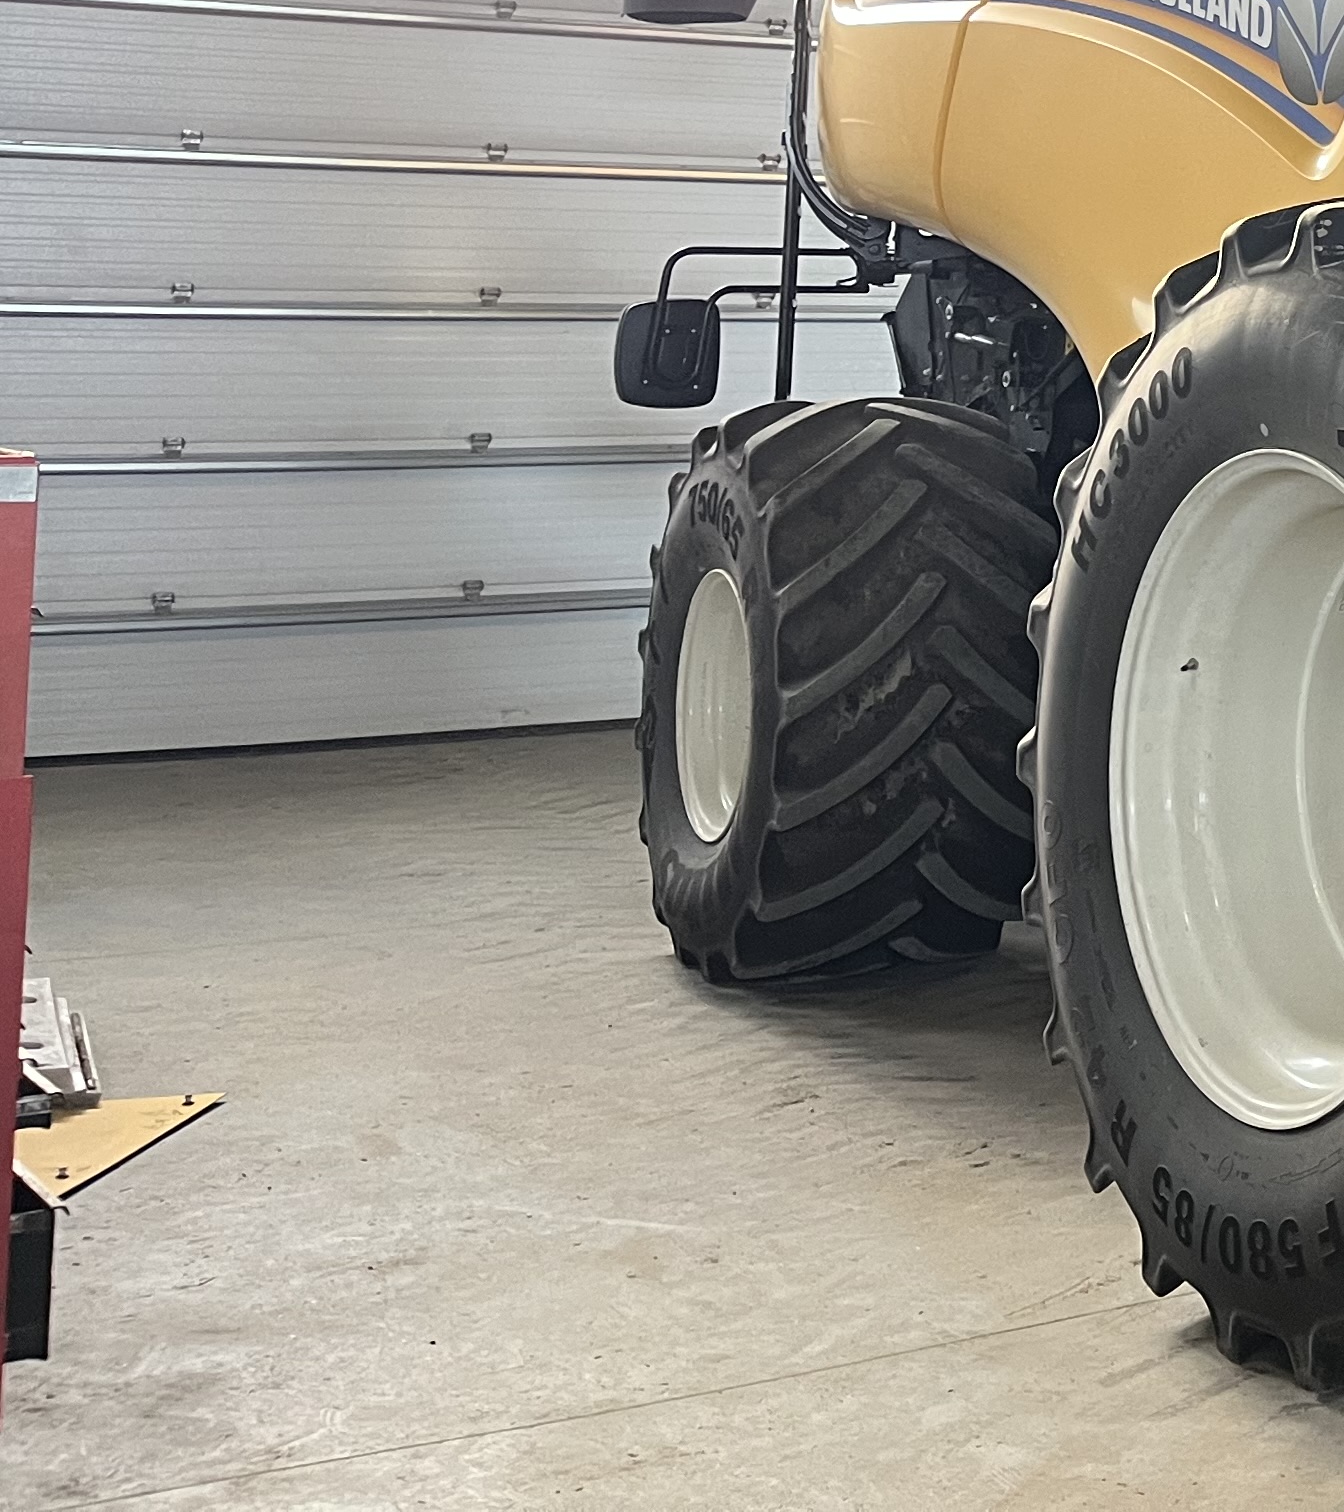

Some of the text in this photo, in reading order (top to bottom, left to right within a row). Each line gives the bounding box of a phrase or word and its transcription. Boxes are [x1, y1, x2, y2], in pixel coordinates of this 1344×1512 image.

[1072, 346, 1193, 573] HC 3000
[688, 478, 745, 562] 750/65
[1150, 1165, 1305, 1278] 580/85
